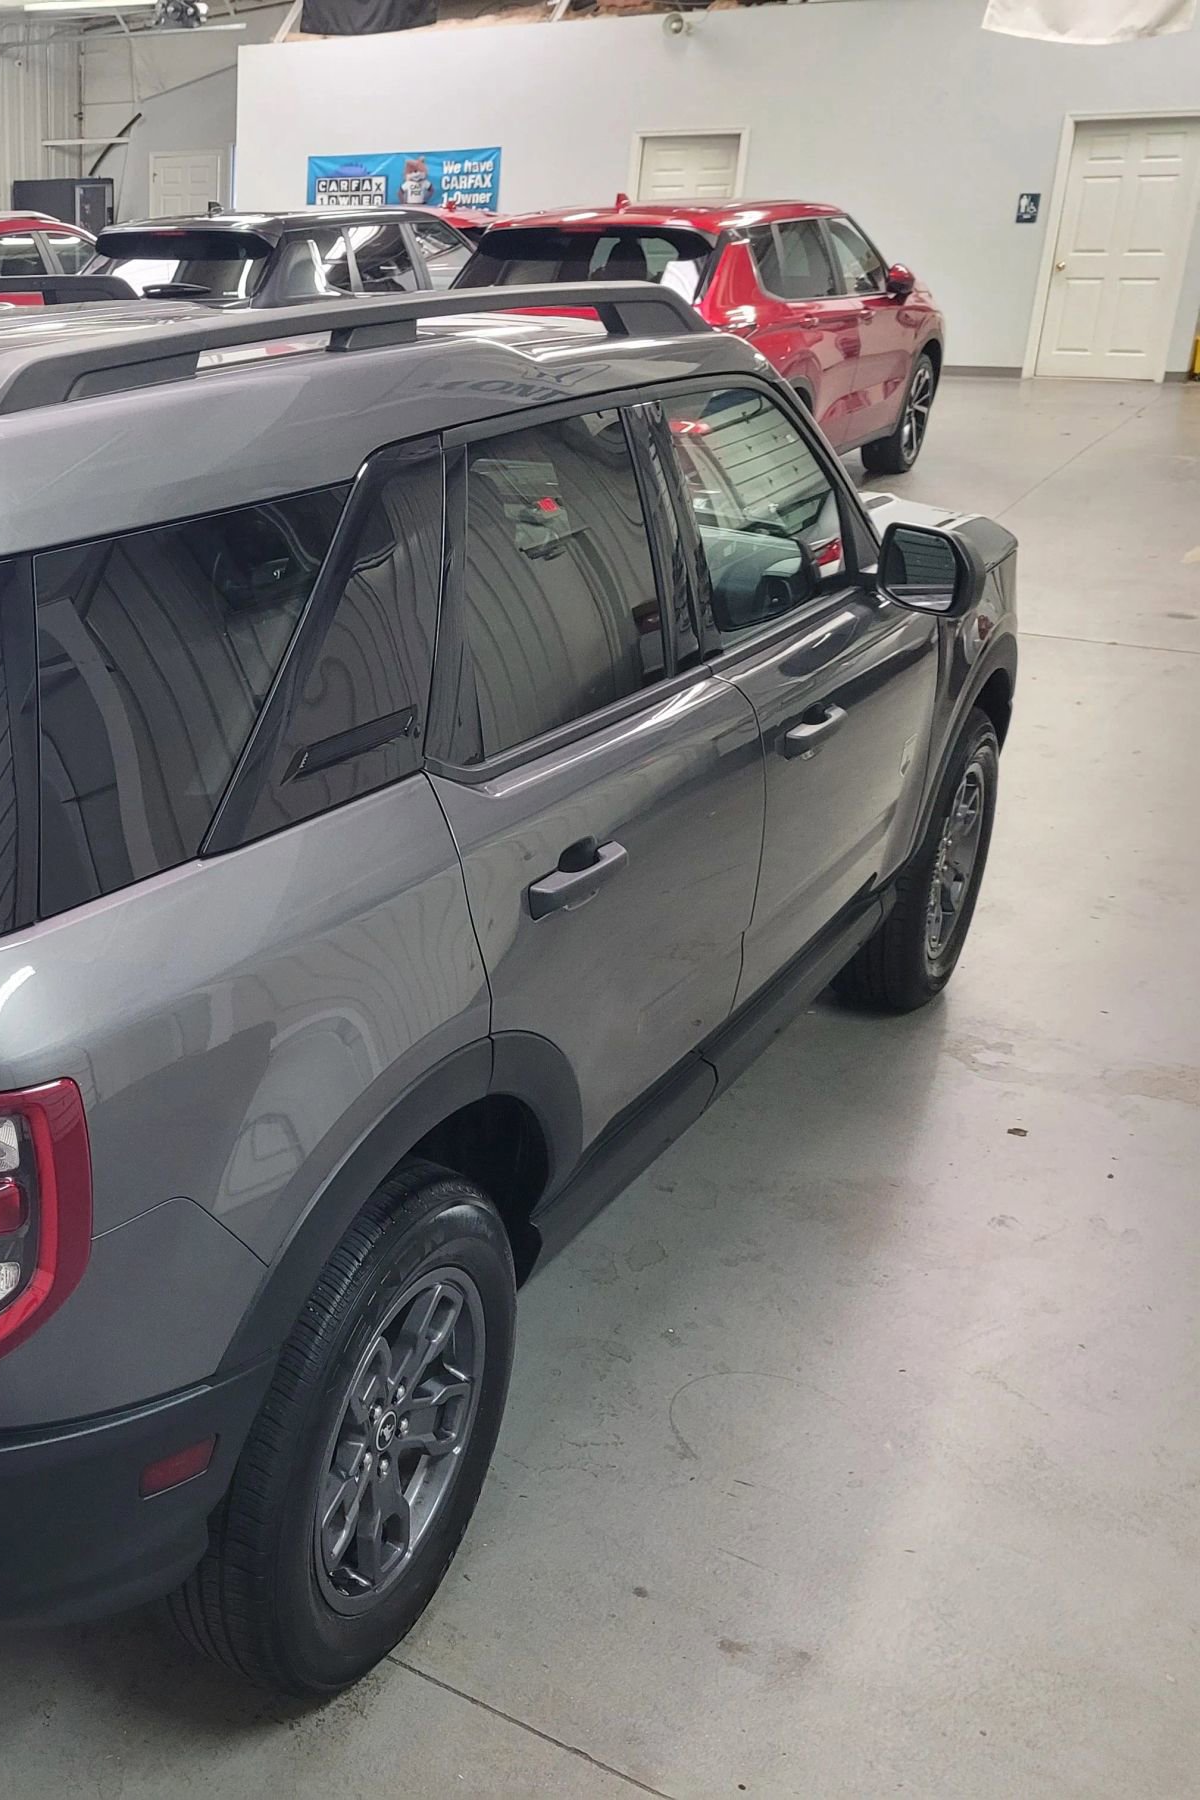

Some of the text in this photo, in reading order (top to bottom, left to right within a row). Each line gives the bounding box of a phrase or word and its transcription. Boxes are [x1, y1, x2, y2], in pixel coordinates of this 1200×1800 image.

[442, 159, 494, 175] We have
[319, 179, 383, 192] CARFAX
[441, 174, 493, 190] CARFAX
[441, 191, 493, 207] 1-Owner
